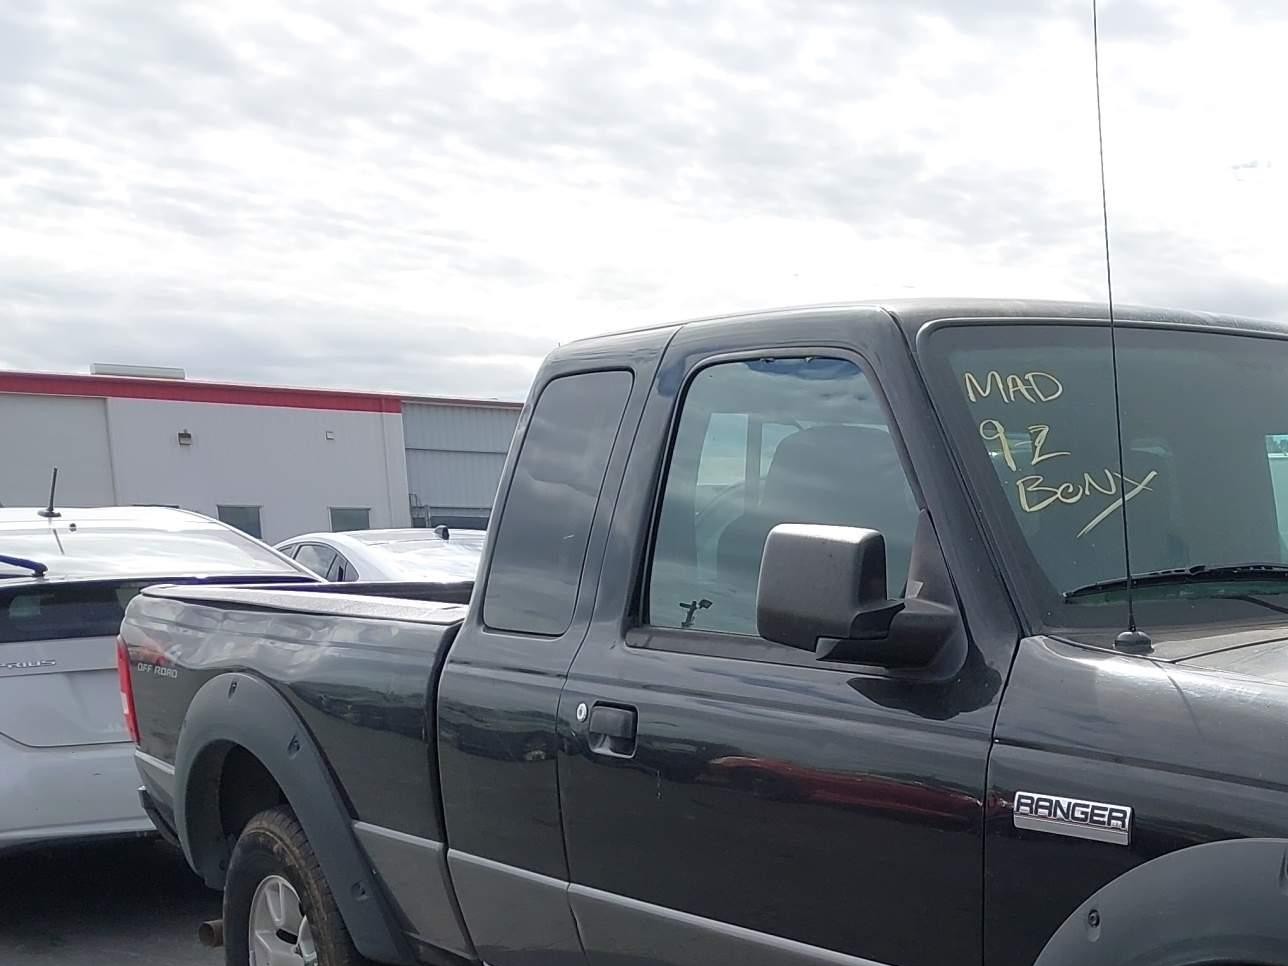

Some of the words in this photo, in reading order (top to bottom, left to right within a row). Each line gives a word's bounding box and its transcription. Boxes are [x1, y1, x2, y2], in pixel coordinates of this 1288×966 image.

[965, 371, 1063, 404] MAD
[137, 662, 153, 673] OFF
[154, 665, 178, 679] ROAD
[1016, 794, 1129, 830] RANGER
